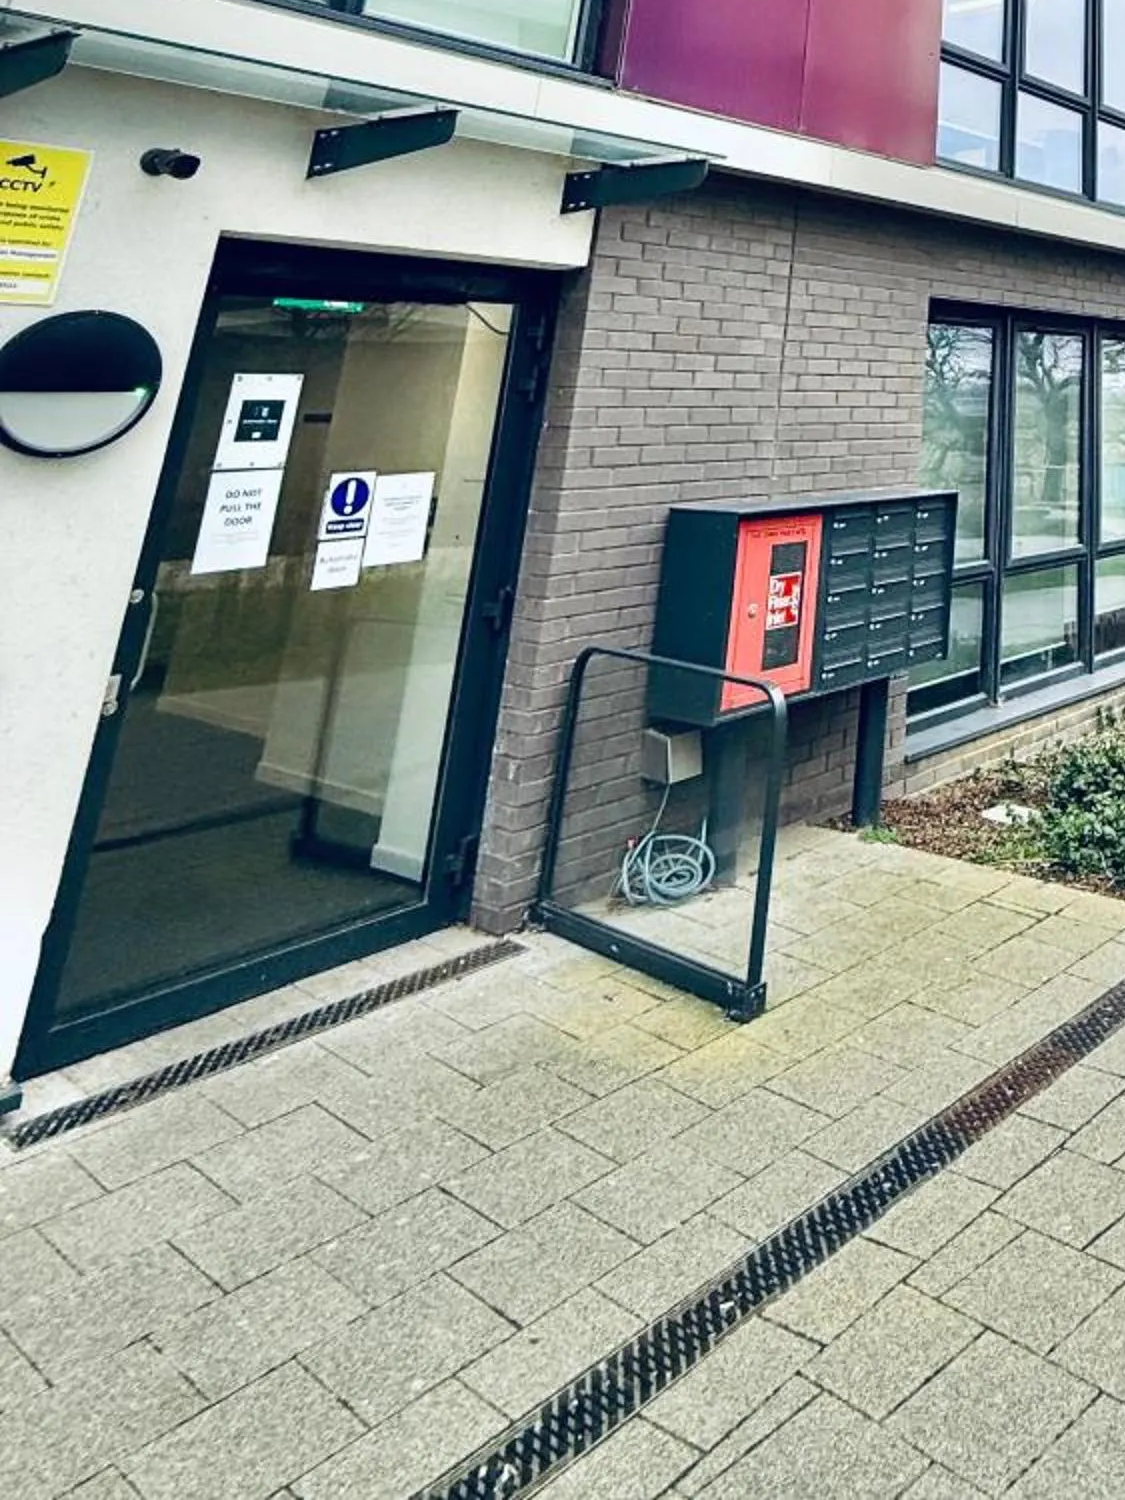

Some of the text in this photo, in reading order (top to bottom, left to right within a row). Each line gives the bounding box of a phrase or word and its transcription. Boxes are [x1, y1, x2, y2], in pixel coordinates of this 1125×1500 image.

[0, 178, 43, 192] CCTV
[225, 487, 262, 499] DO NOT
[219, 501, 262, 513] PULL THE
[223, 515, 253, 526] DOOR
